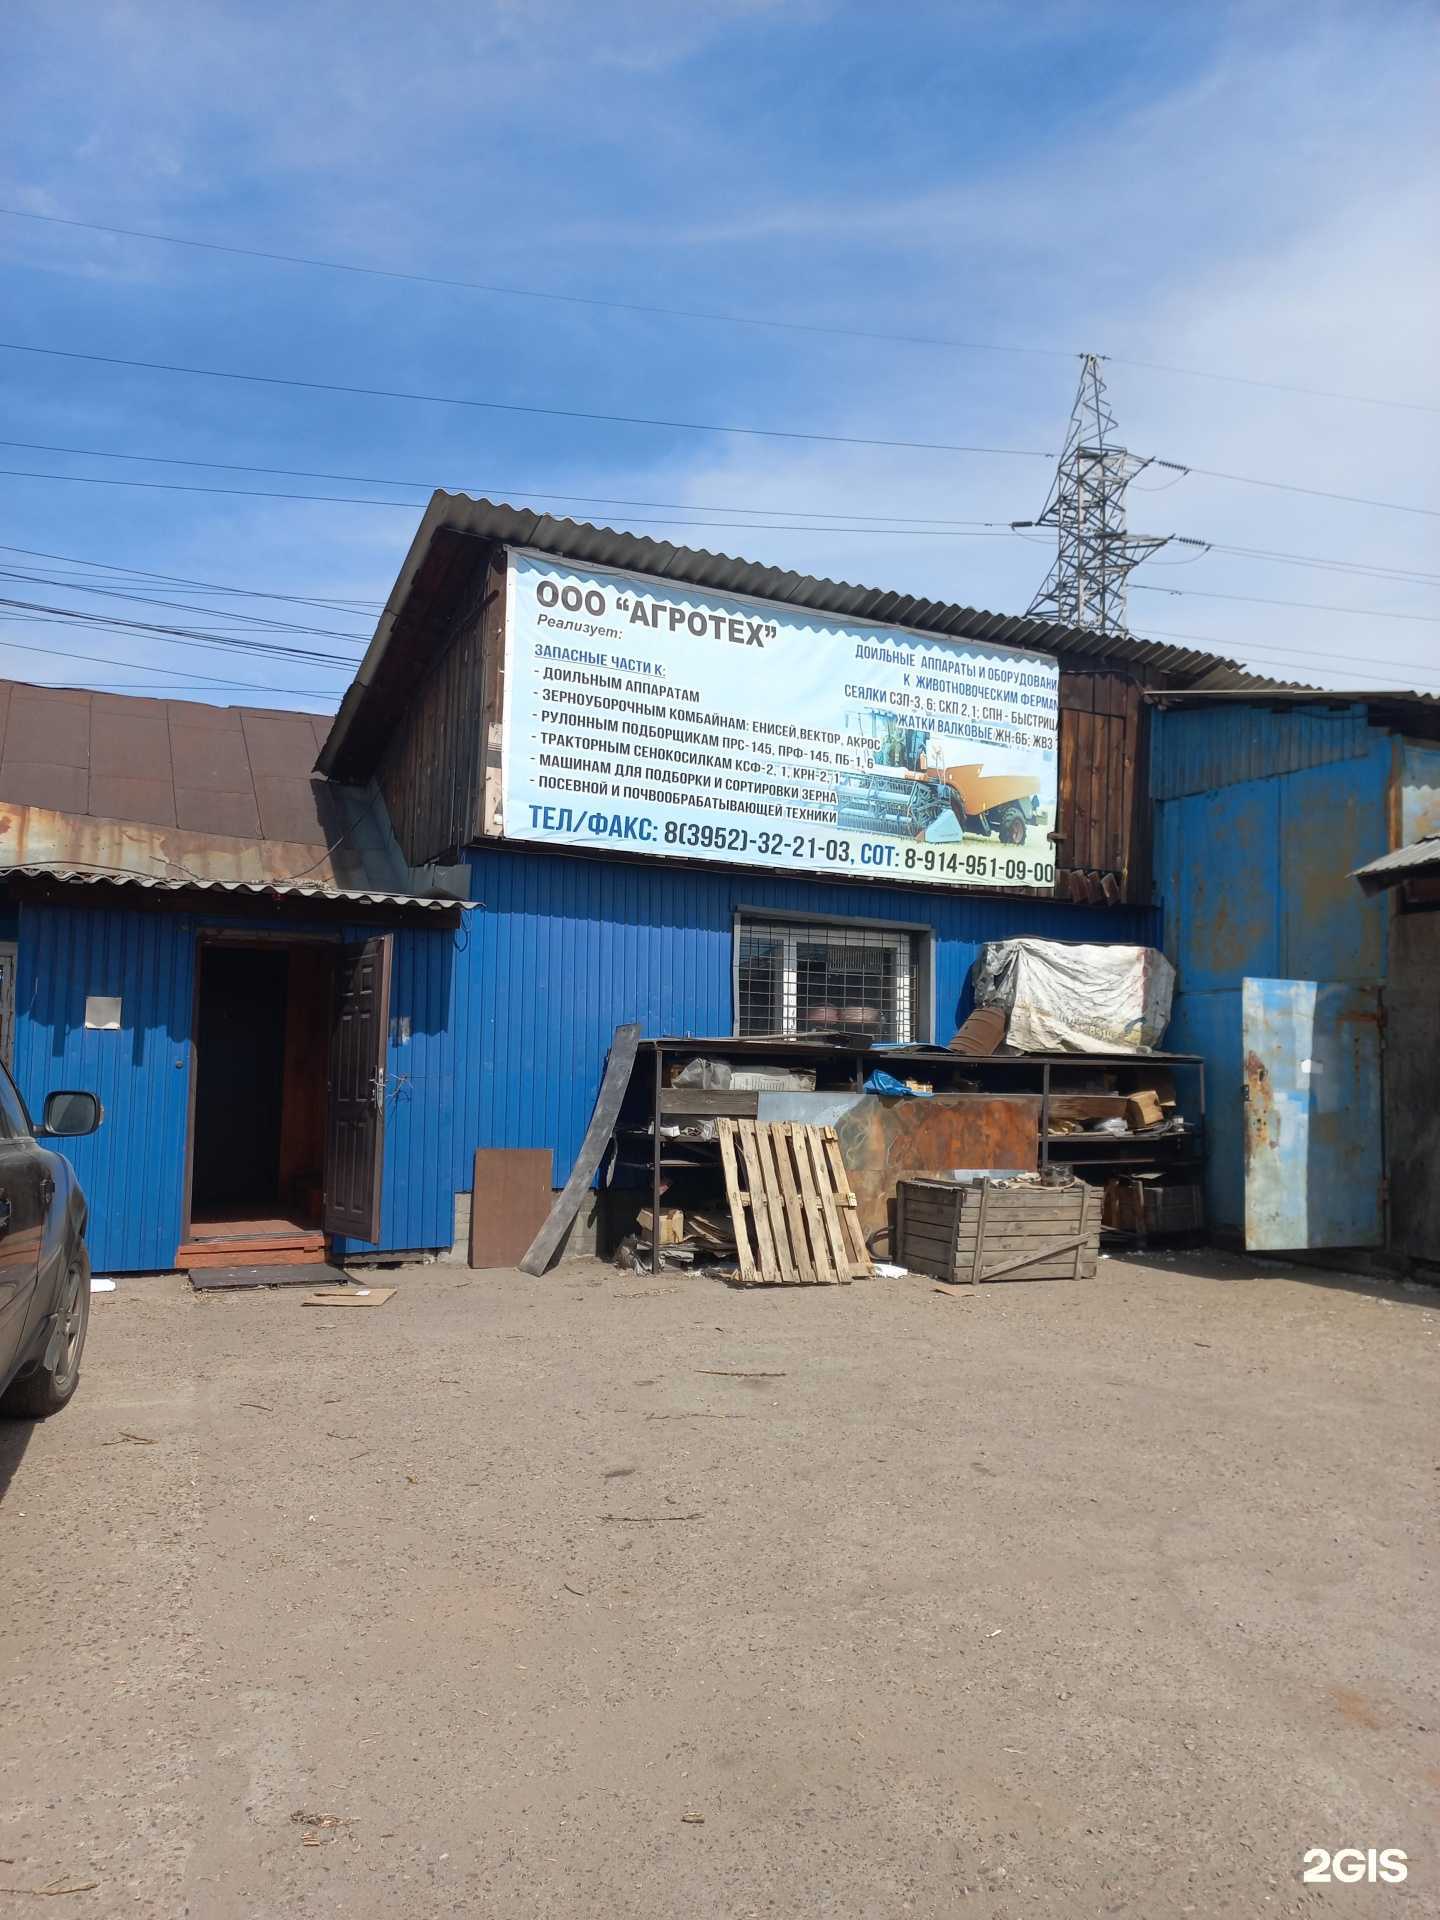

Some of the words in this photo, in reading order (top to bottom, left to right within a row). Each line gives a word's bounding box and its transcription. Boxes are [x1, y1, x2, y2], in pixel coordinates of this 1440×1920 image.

[536, 580, 606, 617] ООО
[537, 613, 623, 640] Реализует:
[534, 643, 608, 667] ЗАПАСНЫЕ
[611, 655, 651, 675] ЧАСТИ
[654, 663, 667, 677] К:
[855, 644, 916, 667] ДОИЛЬНЫЕ
[920, 655, 976, 678] АППАРАТЫ
[978, 666, 986, 679] И
[987, 667, 1057, 691] ОБОРУДОВАНИ
[543, 666, 622, 691] ДОИЛЬНЫМ
[625, 679, 700, 703] АППАРАТАМ
[903, 673, 910, 687] К
[916, 675, 1018, 704] ЖИВОТНОВОЧЕСКИМ
[542, 688, 666, 718] ЗЕРНОУБОРОЧНЫМ
[669, 708, 749, 732] КОМБАЙНАМ:
[846, 736, 881, 751] АКРОС
[844, 684, 887, 703] СЕЯЛКИ
[939, 699, 959, 715] СКП
[982, 706, 1003, 721] СПН
[1011, 711, 1058, 731] БЫСТРИЦ
[898, 713, 935, 731] ЖАТКИ
[937, 719, 993, 740] ВАЛКОВЫЕ
[541, 710, 618, 733] РУЛОННЫМ
[622, 721, 719, 748] ПОДБОРЩИКАМ
[540, 732, 630, 755] ТРАКТОРНЫМ
[633, 744, 732, 770] СЕНОКОСИЛКАМ
[539, 753, 611, 775] МАШИНАМ
[614, 763, 642, 778] ДЛЯ
[645, 767, 711, 788] ПОДБОРКИ
[714, 777, 722, 789] И
[725, 778, 799, 799] СОРТИРОВКИ
[801, 788, 837, 804] ЗЕРНА
[539, 775, 608, 796] ПОСЕВНОЙ
[611, 784, 620, 797] И
[623, 786, 783, 817] ПОЧВООБРАБАТЫВАЮЩЕЙ
[786, 807, 837, 823] ТЕХНИКИ
[528, 804, 658, 843] ТЕЛ/ФАКС:
[860, 842, 900, 868] СОТ:
[904, 848, 1055, 883] 8-914-951-09-00
